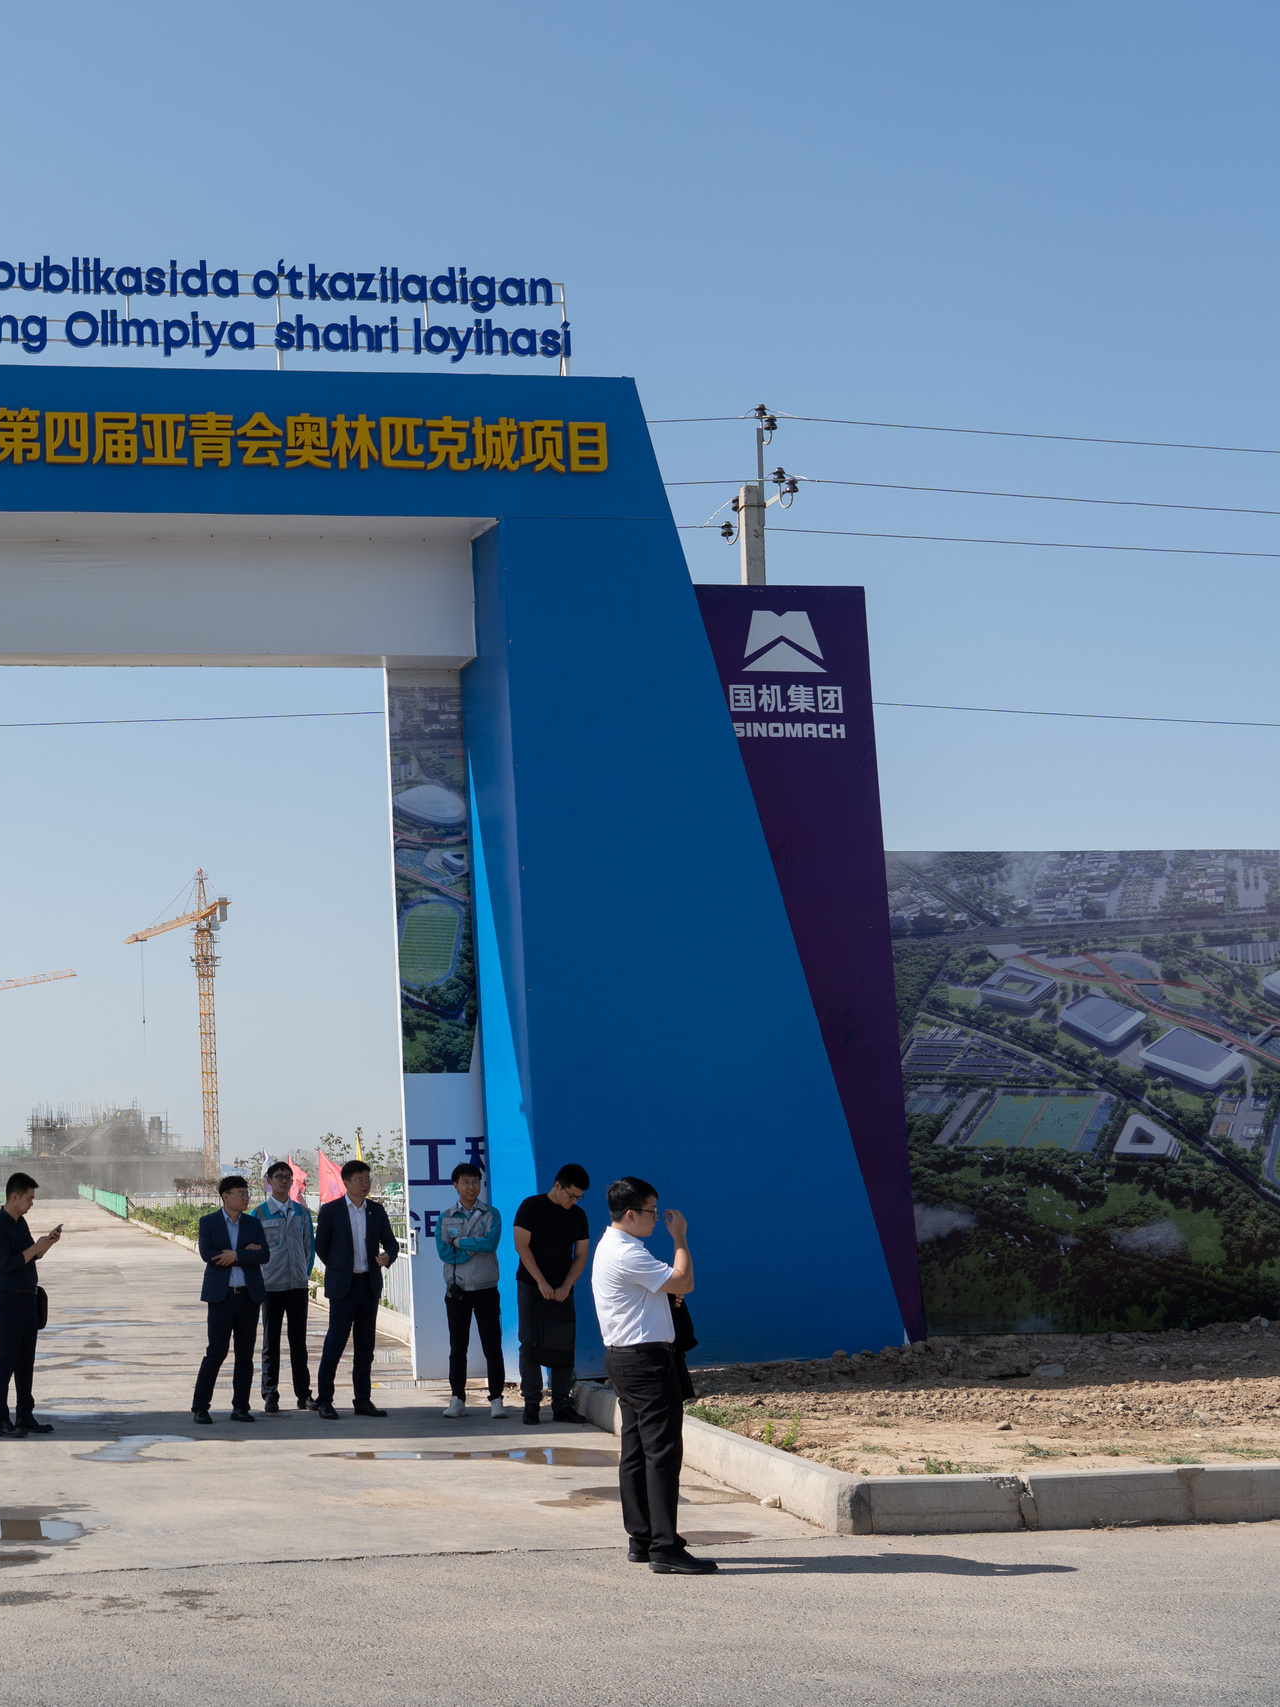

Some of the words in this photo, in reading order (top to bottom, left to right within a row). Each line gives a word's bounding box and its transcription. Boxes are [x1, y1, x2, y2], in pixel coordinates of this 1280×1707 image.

[65, 310, 255, 357] Olimpiya
[274, 315, 399, 355] shahri
[413, 318, 572, 363] loyihasi
[728, 684, 844, 714] 国机集团
[732, 722, 846, 739] SINOMACH
